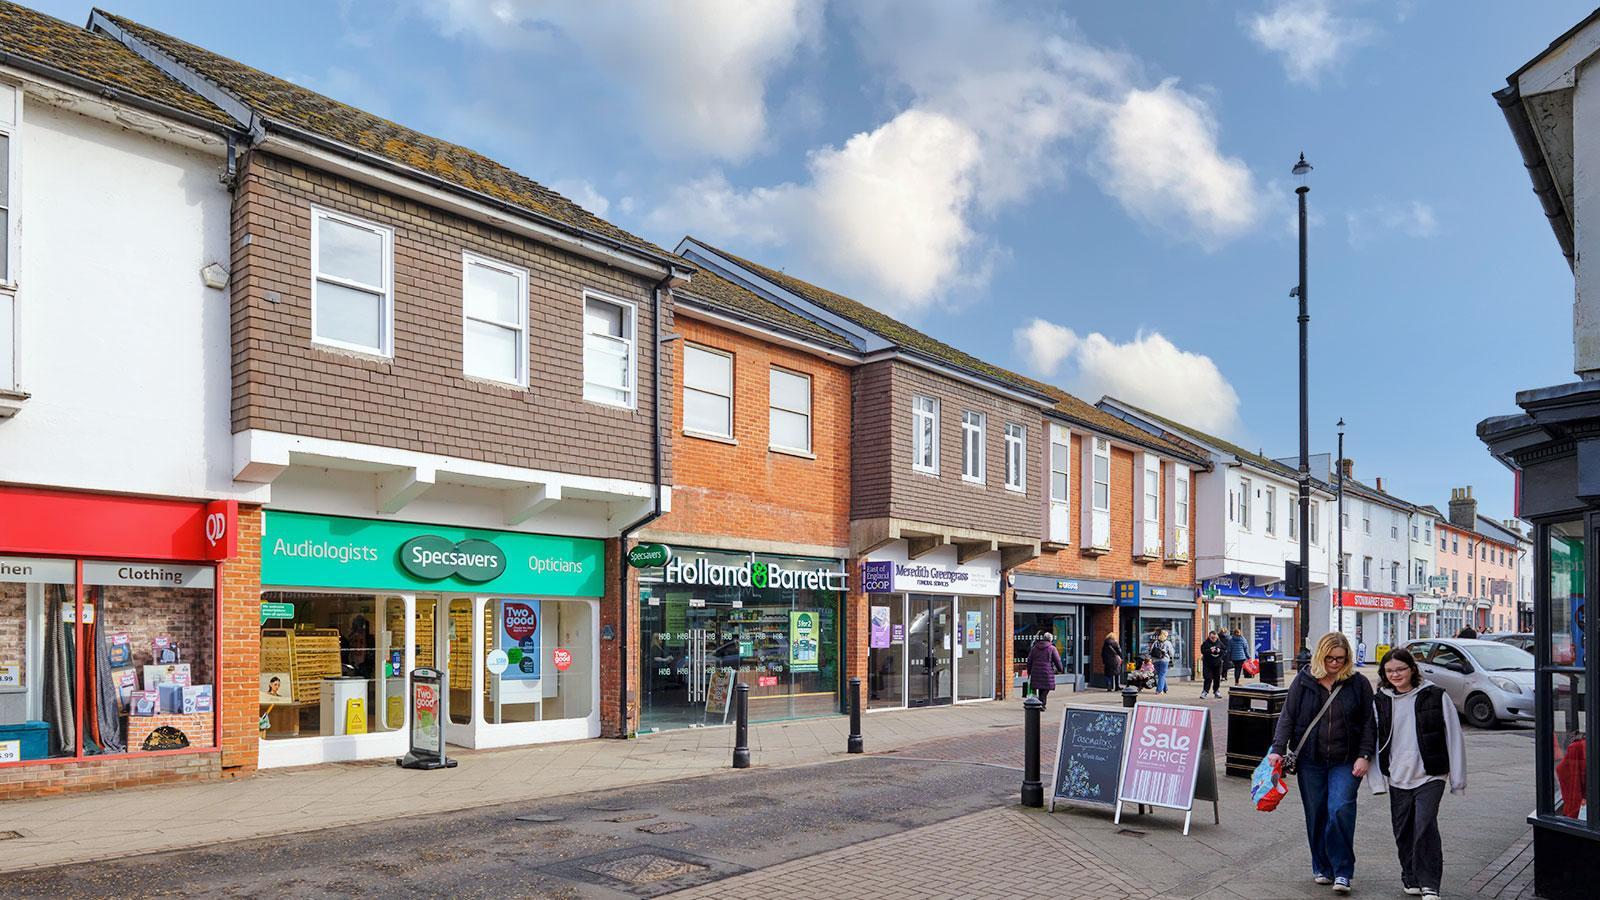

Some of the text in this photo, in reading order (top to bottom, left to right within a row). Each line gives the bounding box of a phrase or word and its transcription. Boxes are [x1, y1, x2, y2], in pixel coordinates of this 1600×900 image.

[206, 513, 225, 547] QD
[273, 538, 378, 563] Audiologists
[412, 546, 498, 568] Specsavers
[630, 550, 662, 561] Specsavers
[528, 555, 583, 574] Opticians
[118, 567, 182, 584] Clothing
[666, 557, 751, 587] Holland
[768, 563, 833, 590] Barrett
[867, 572, 889, 581] England
[895, 564, 929, 579] Meredith
[930, 567, 969, 583] Greengrass
[506, 607, 528, 617] Two
[506, 615, 534, 628] good
[555, 650, 567, 658] Two
[555, 655, 570, 663] good
[416, 689, 431, 699] Two
[416, 698, 434, 708] good
[1140, 725, 1190, 751] Sale
[1149, 749, 1188, 765] PRICE
